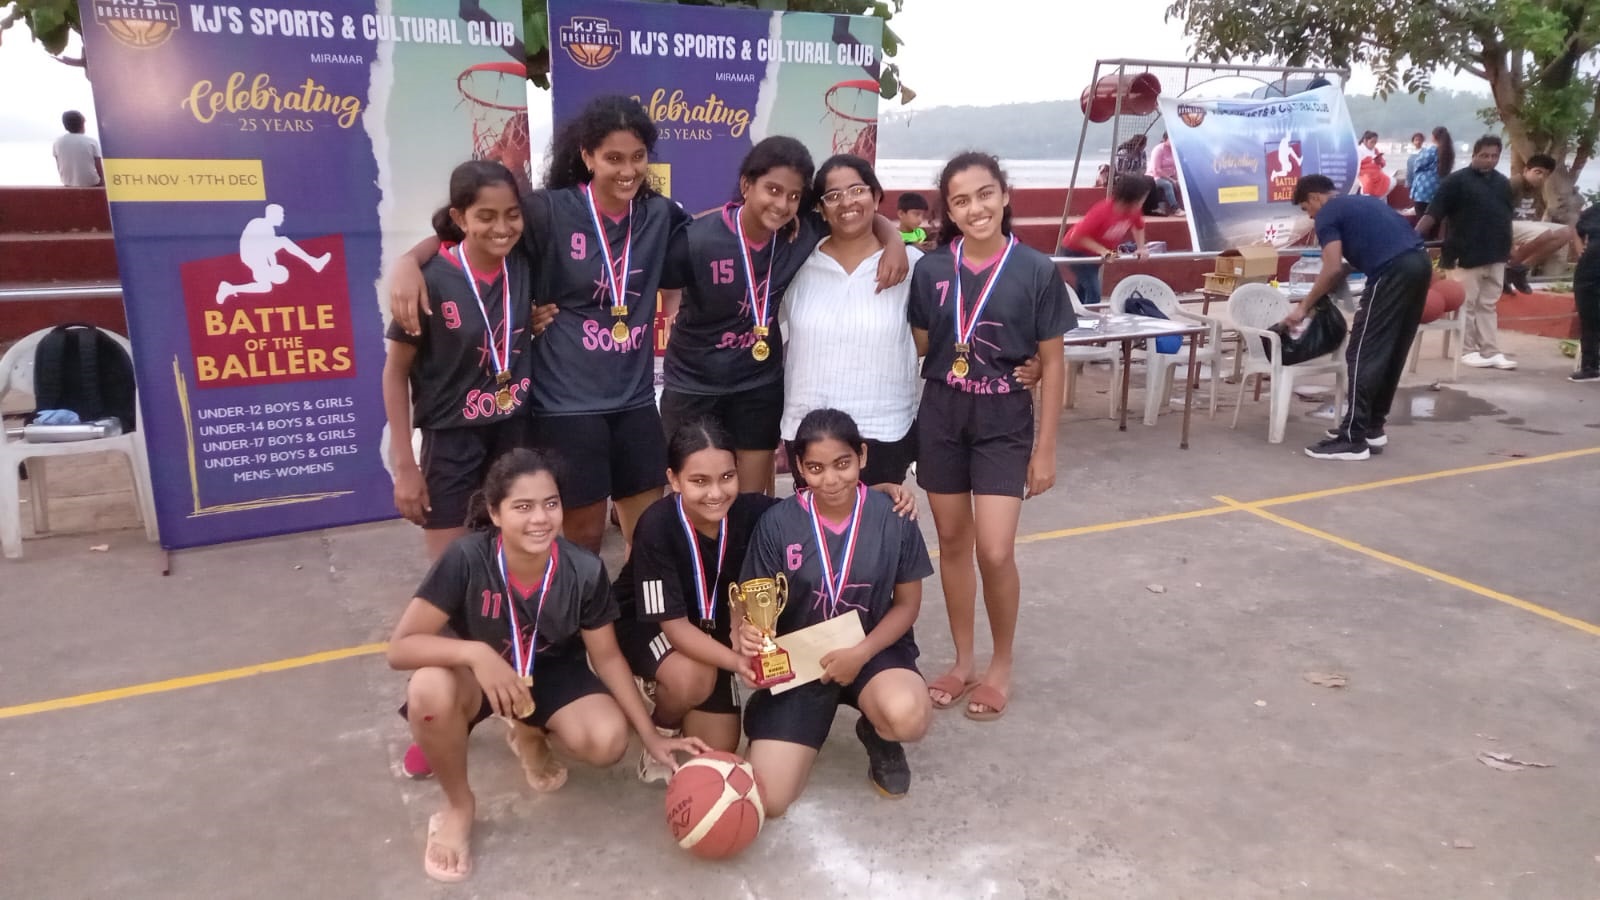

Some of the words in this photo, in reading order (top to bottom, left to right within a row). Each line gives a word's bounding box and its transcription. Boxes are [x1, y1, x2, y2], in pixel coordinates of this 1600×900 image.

[97, 6, 177, 21] BASKETBALL
[190, 4, 244, 34] KJ'S
[250, 8, 335, 39] SPORTS
[341, 15, 356, 40] &
[362, 14, 462, 45] CULTURAL
[467, 20, 515, 47] CLUB
[562, 32, 620, 46] BASKETBALL
[573, 21, 607, 34] KJ'S
[310, 53, 364, 65] MIRAMAR
[630, 30, 669, 57] KJ'S
[673, 33, 736, 60] SPORTS
[741, 40, 752, 60] &
[757, 38, 832, 65] CULTURAL
[837, 43, 874, 67] CLUB
[715, 72, 755, 83] MIRAMAR
[181, 71, 363, 129] Celebrating
[239, 118, 257, 132] 25
[261, 119, 314, 132] YEARS
[630, 88, 750, 138] lebrating
[658, 128, 670, 139] 25
[674, 128, 712, 140] YEARS
[112, 174, 143, 186] 8TH
[147, 174, 179, 186] NOV
[228, 175, 258, 186] DEC
[571, 232, 586, 259] 9
[710, 259, 735, 284] 15
[936, 280, 950, 306] 7
[204, 304, 335, 336] BATTLE
[441, 301, 462, 329] 9
[244, 339, 268, 352] OF
[272, 336, 304, 350] THE
[197, 346, 351, 381] BALLERS
[198, 405, 262, 420] UNDER-12
[265, 401, 300, 414] BOYS
[303, 400, 313, 410] &
[315, 397, 354, 409] GIRLS
[200, 421, 265, 436] UNDER-14
[267, 417, 303, 430] BOYS
[305, 416, 315, 426] &
[317, 412, 356, 425] GIRLS
[202, 437, 265, 453] UNDER-17
[268, 433, 303, 447] BOYS
[306, 432, 316, 442] &
[318, 428, 356, 441] GIRLS
[204, 453, 267, 469] UNDER-19
[270, 449, 305, 463] BOYS
[308, 448, 318, 458] &
[320, 444, 358, 457] GIRLS
[233, 462, 335, 482] MENS-WOMENS
[786, 543, 803, 571] 6
[481, 589, 502, 619] 11
